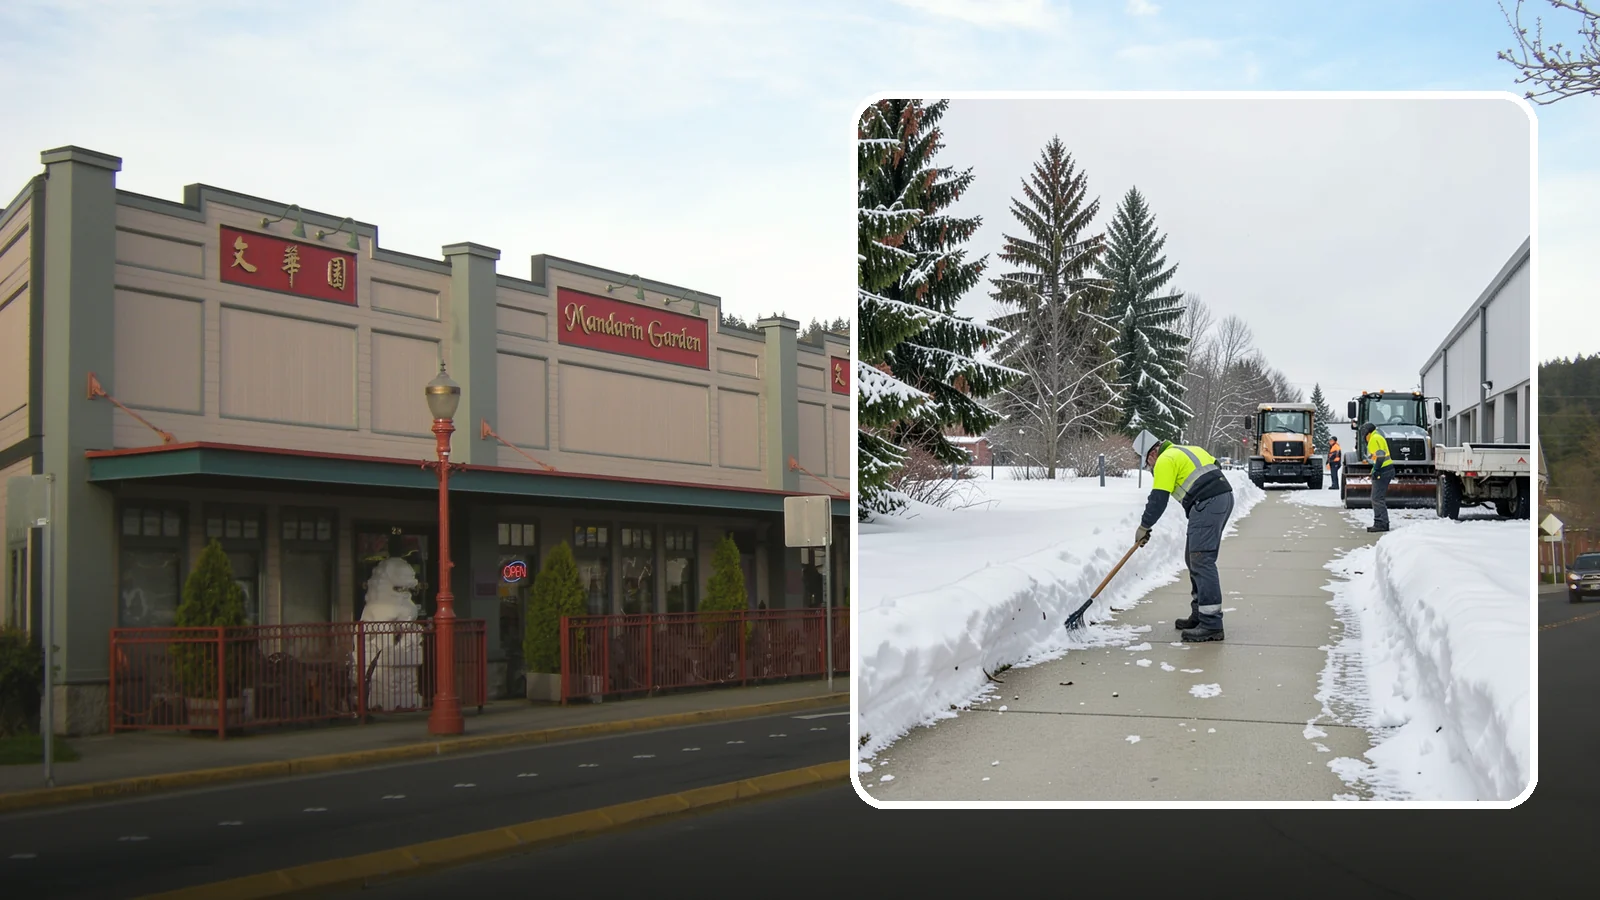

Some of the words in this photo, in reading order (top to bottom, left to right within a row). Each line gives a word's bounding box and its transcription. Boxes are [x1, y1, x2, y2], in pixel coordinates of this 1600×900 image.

[231, 236, 346, 291] 文華園
[564, 302, 644, 341] Mandarin
[647, 320, 702, 352] Garden
[834, 363, 846, 386] 文
[503, 565, 527, 578] OPEN
